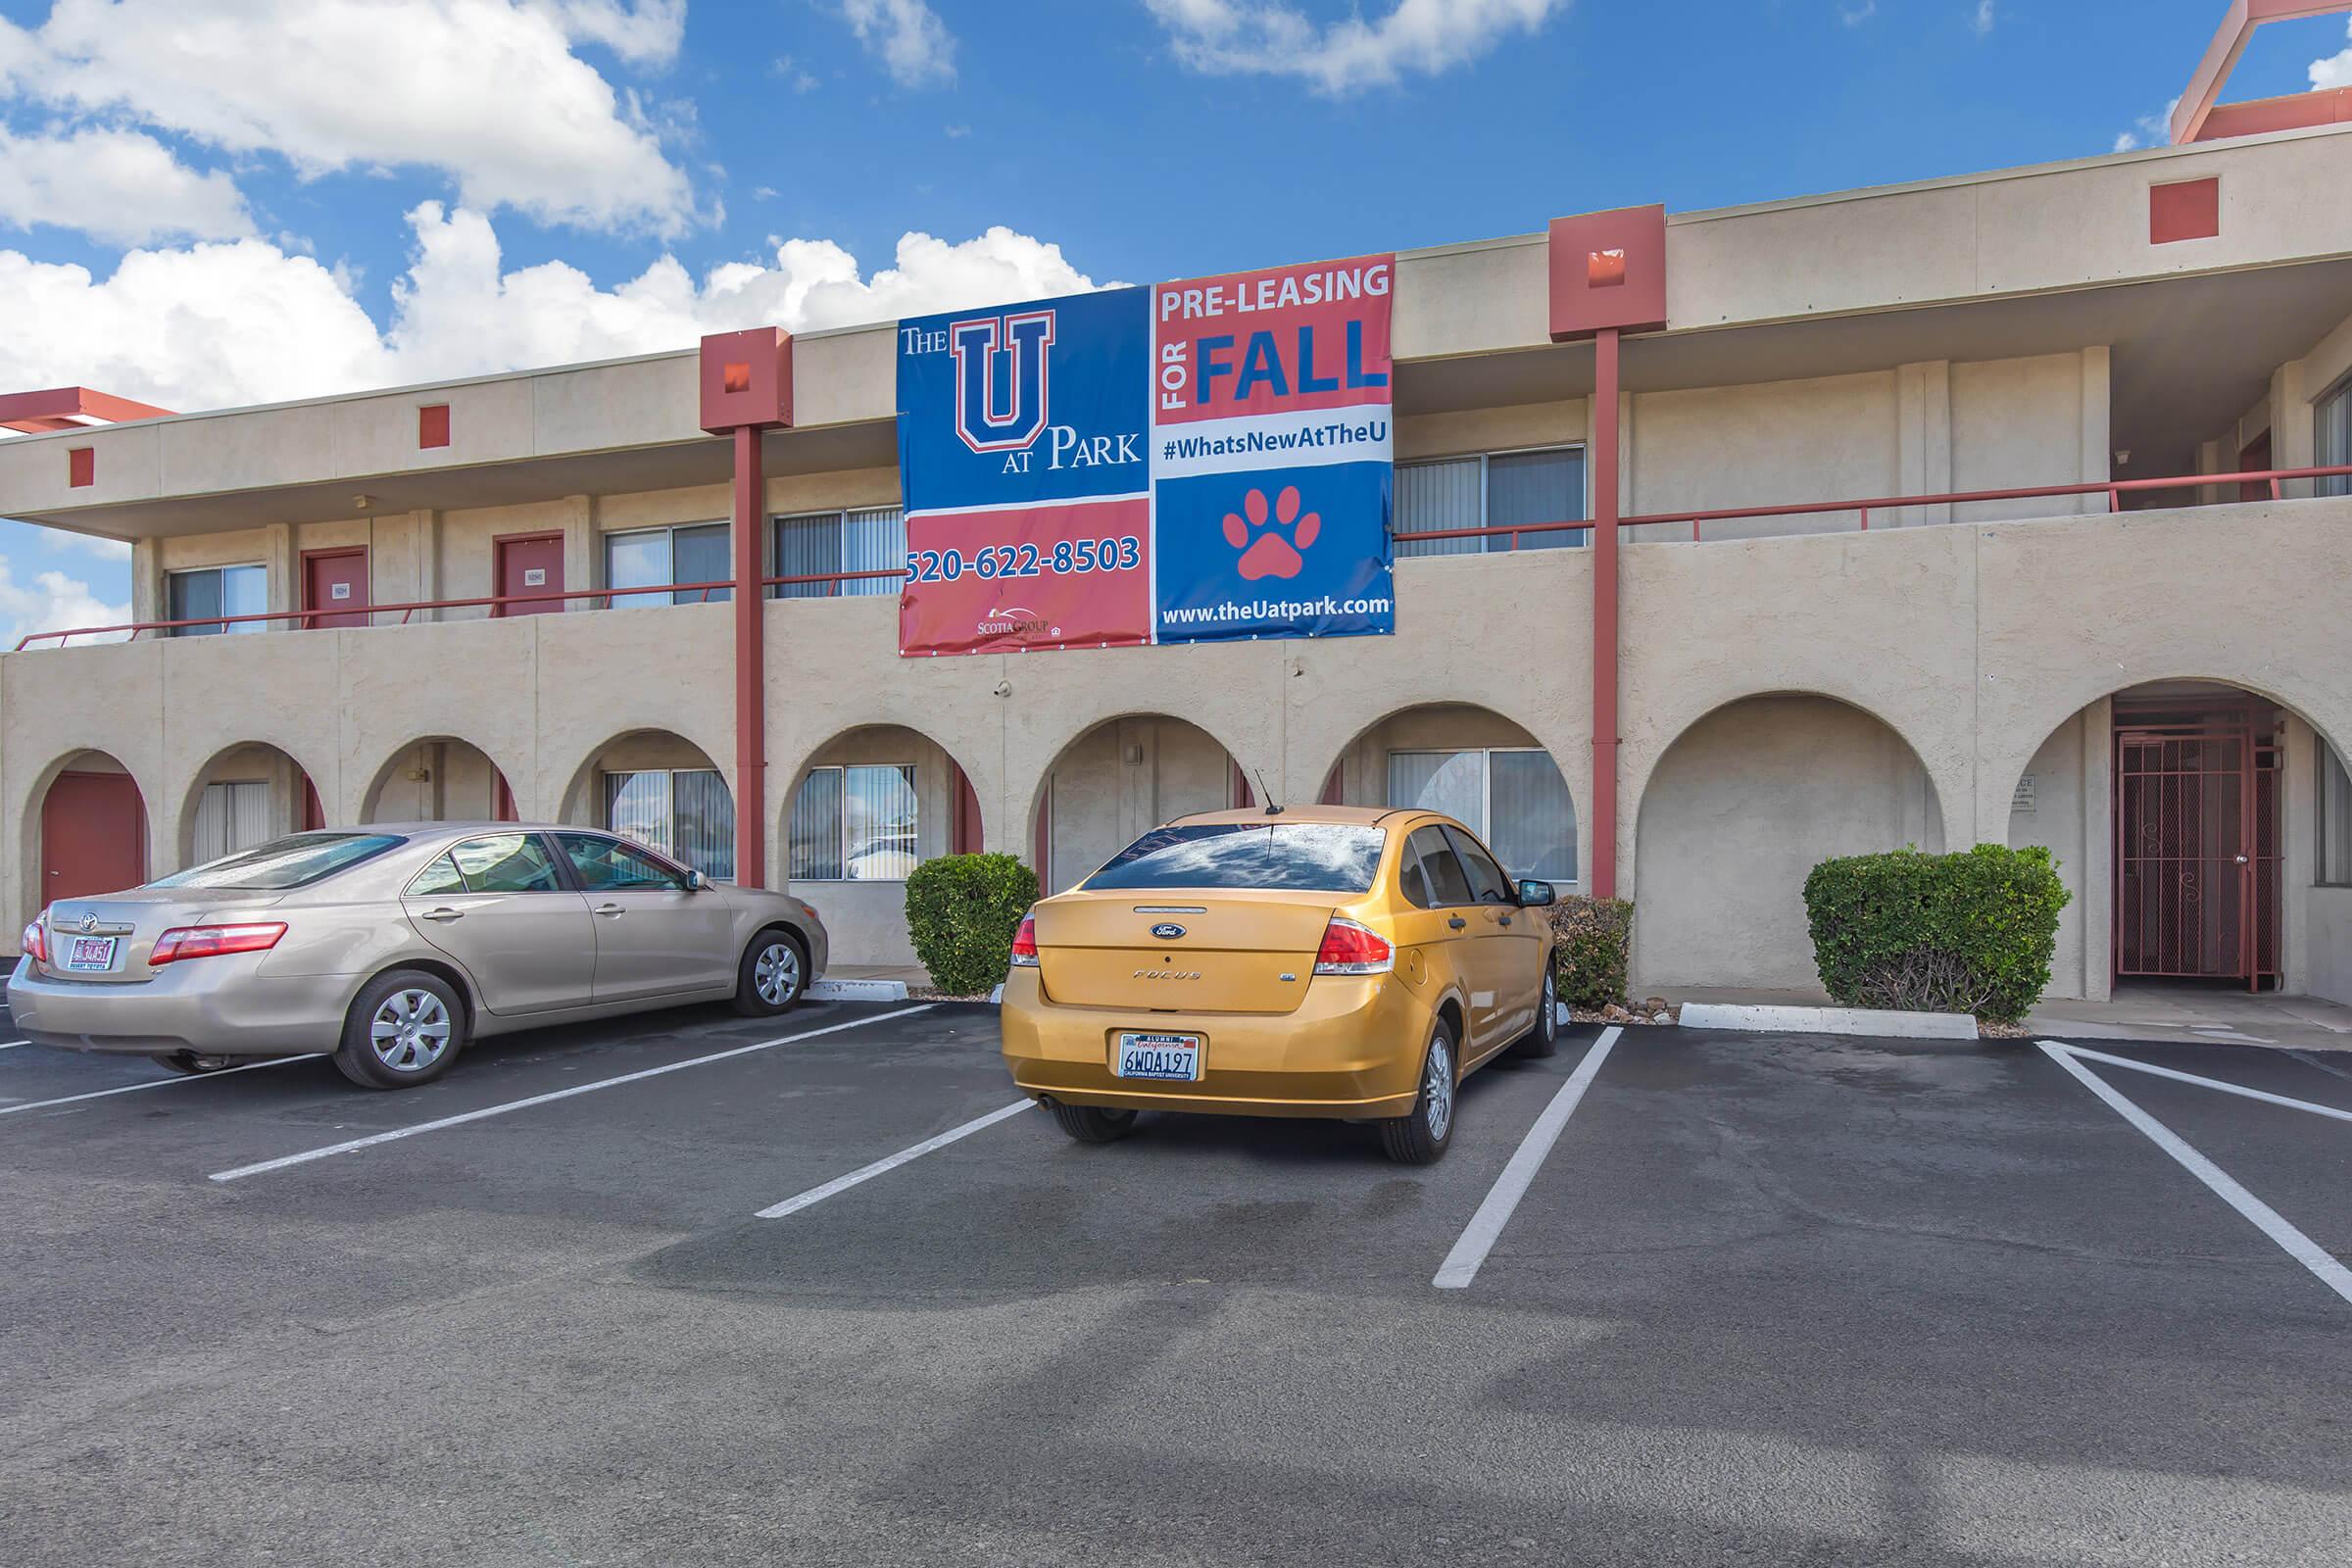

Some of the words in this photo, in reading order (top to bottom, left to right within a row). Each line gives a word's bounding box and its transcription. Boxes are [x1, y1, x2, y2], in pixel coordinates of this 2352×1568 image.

[1161, 265, 1389, 321] PRE-LEASING
[901, 327, 948, 355] THE
[950, 309, 1055, 454] U
[1161, 341, 1187, 410] FOR
[1197, 319, 1388, 405] FALL
[1002, 452, 1033, 473] AT
[1047, 425, 1142, 470] PARK
[1163, 421, 1387, 461] #WhatsNewAtTheU
[906, 535, 1141, 585] 520-622-8503
[1162, 596, 1390, 624] www.theUatpark.com
[1133, 969, 1202, 980] FOCUS
[1136, 1041, 1185, 1052] California
